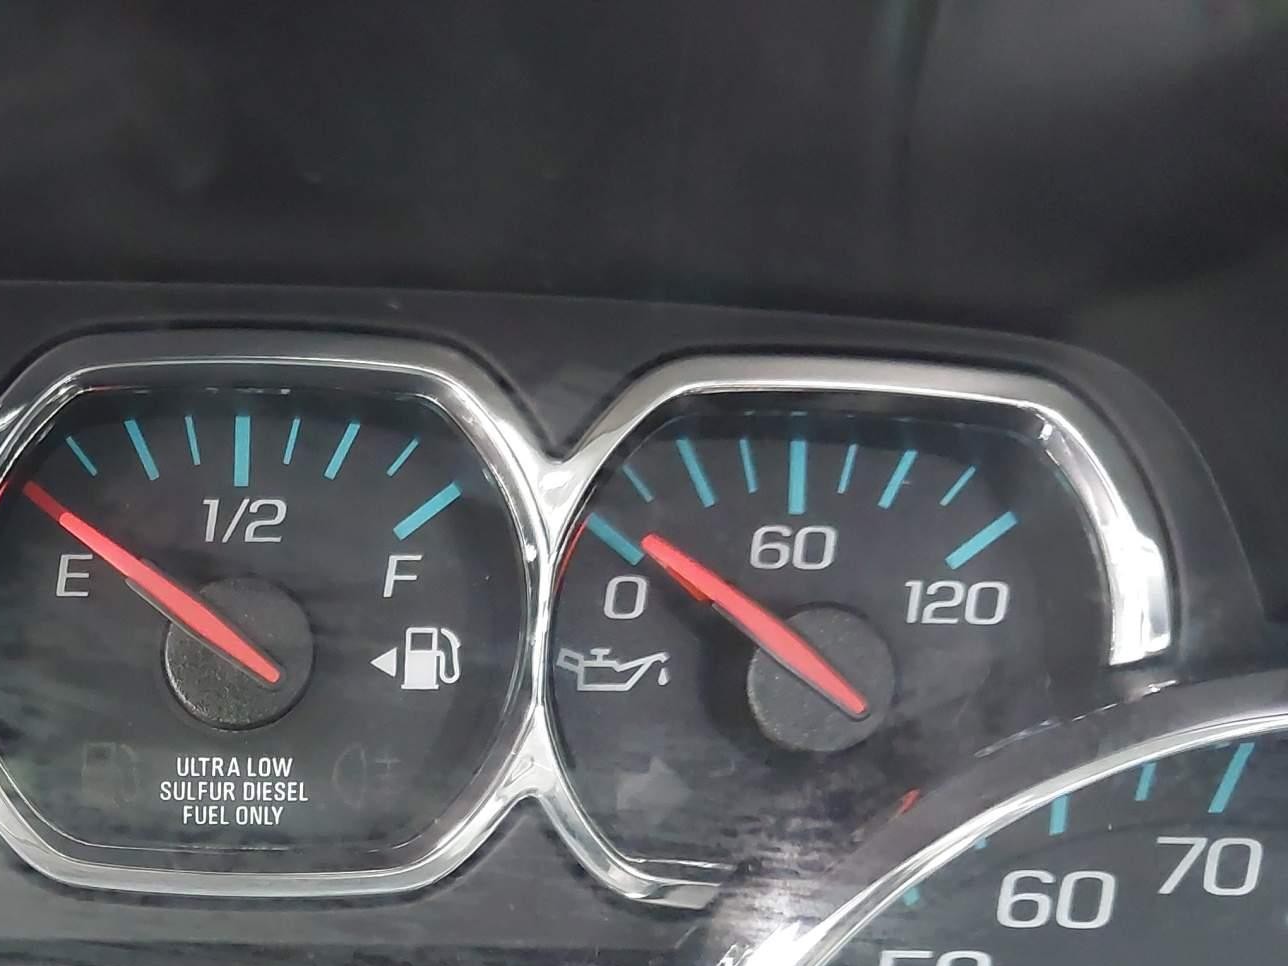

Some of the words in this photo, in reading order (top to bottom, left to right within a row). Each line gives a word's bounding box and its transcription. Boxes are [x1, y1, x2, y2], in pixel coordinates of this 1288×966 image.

[204, 498, 286, 542] 1/2
[751, 526, 836, 569] 60
[56, 554, 92, 596] E
[384, 555, 422, 597] F
[604, 576, 647, 619] 0
[906, 581, 1008, 624] 120
[177, 757, 240, 776] ULTRA
[248, 758, 292, 777] LOW
[160, 782, 235, 800] SULFUR
[244, 782, 308, 801] DIESEL
[184, 806, 229, 824] FUEL
[236, 806, 283, 825] ONLY
[1157, 837, 1262, 895] 70
[997, 870, 1115, 928] 60
